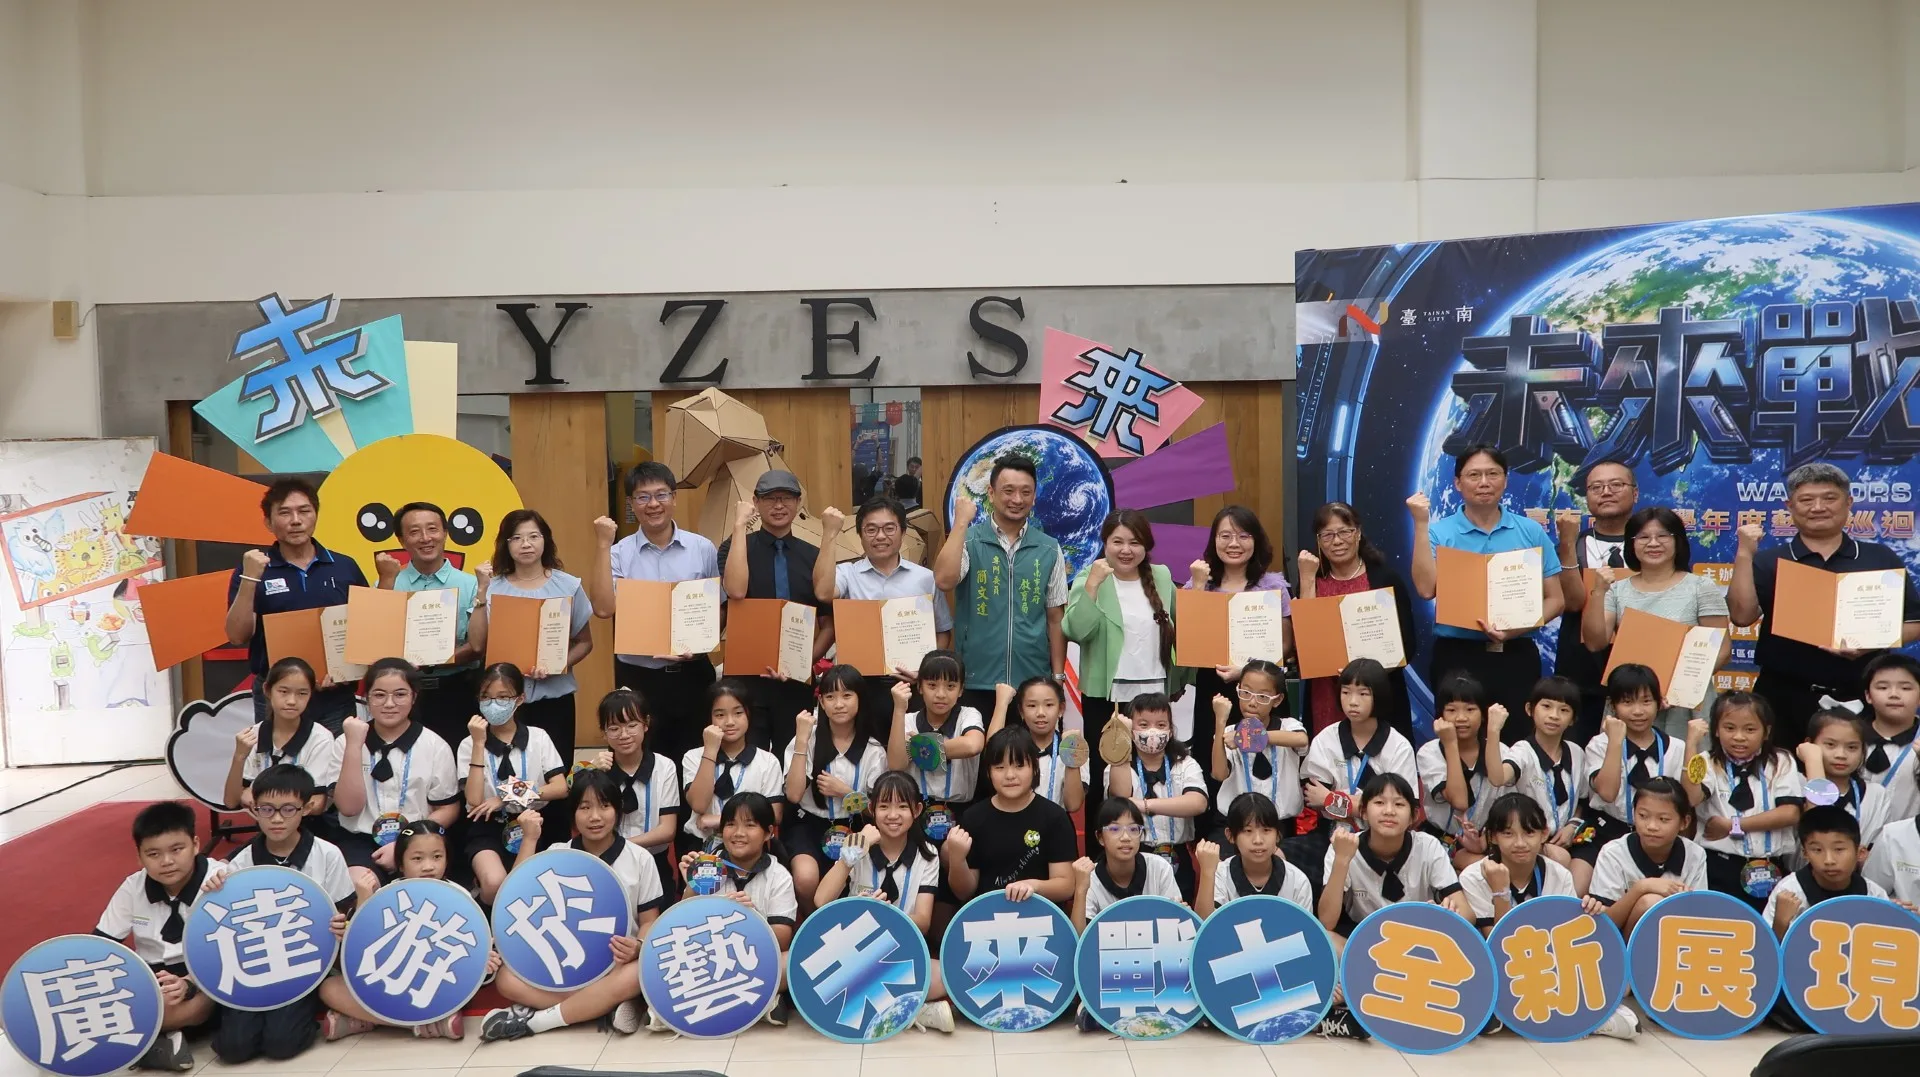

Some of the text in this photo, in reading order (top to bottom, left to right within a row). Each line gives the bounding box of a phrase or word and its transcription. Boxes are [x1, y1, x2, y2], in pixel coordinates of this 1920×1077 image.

[1049, 346, 1182, 456] 來
[1736, 482, 1912, 503] WAORS
[204, 884, 323, 996] 達
[356, 889, 478, 1010] 游
[505, 867, 616, 985] 於
[651, 911, 766, 1025] 藝
[799, 910, 917, 1031] 未
[962, 911, 1064, 1017] 來
[1097, 918, 1201, 1018] 戰
[1209, 918, 1323, 1029] 士
[1360, 919, 1477, 1036] 全
[1502, 914, 1606, 1024] 新
[1650, 914, 1757, 1019] 展
[1805, 919, 1920, 1030] 現
[21, 951, 145, 1066] 廣
